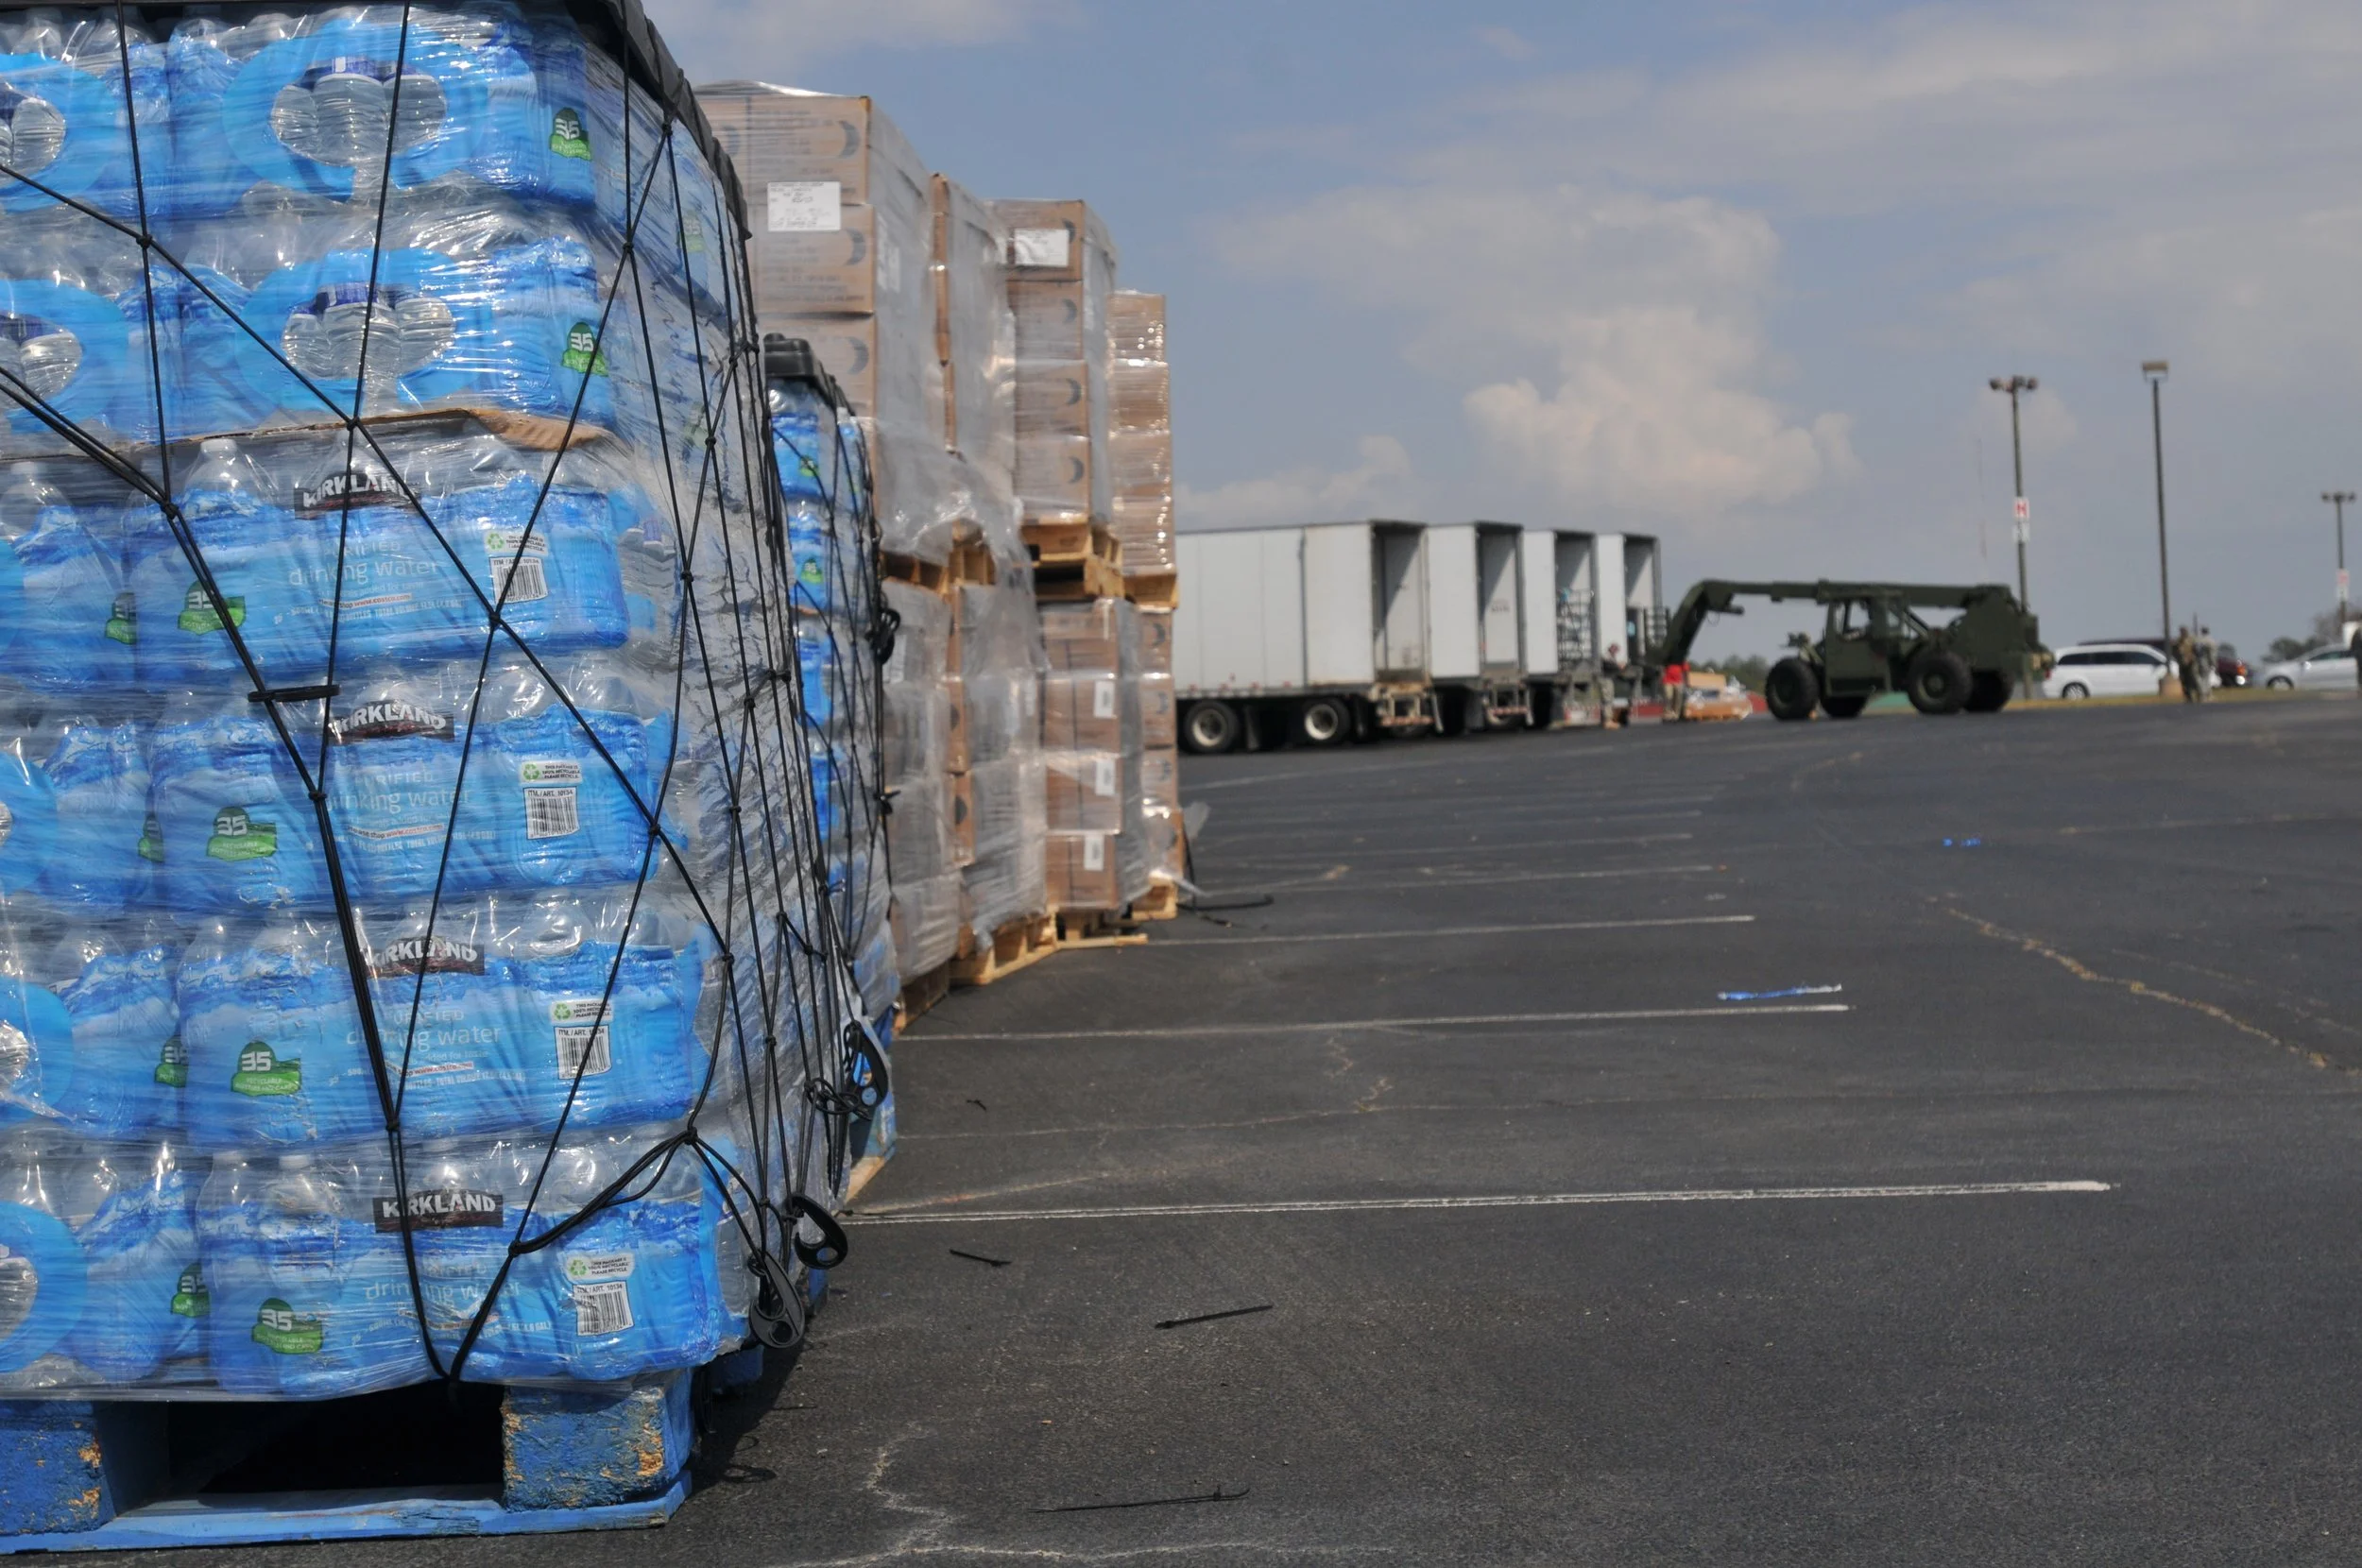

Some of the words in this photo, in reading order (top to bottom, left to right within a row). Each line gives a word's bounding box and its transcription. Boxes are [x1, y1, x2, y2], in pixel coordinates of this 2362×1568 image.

[555, 118, 579, 140] 35
[570, 332, 594, 351] 35
[375, 557, 438, 577] water
[335, 703, 447, 734] KIRKLAND
[408, 789, 472, 808] water
[217, 815, 248, 836] 35
[437, 1025, 502, 1046] water
[242, 1051, 271, 1071] 35
[382, 1193, 496, 1218] KRKLAND
[364, 1281, 454, 1309] drining
[261, 1308, 293, 1332] 35
